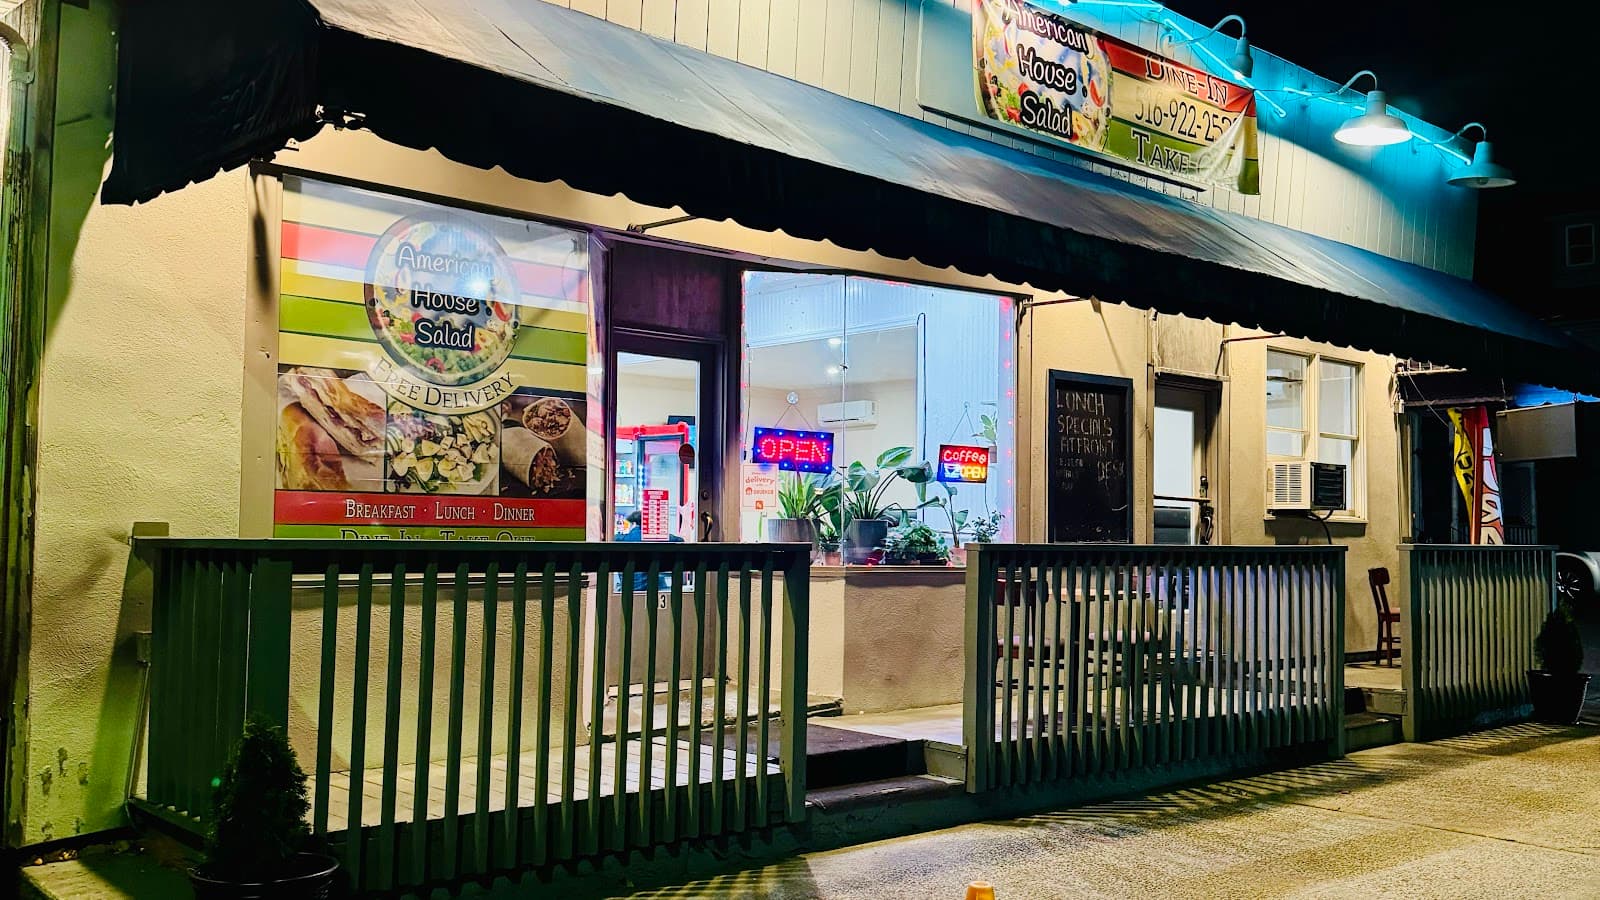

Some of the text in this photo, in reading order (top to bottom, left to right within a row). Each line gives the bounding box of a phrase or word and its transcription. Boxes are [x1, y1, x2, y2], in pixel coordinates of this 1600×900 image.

[1004, 0, 1086, 52] American
[1017, 45, 1076, 92] House
[1146, 54, 1228, 106] DINE-IN
[1021, 94, 1072, 137] Salad
[397, 246, 493, 277] American
[413, 283, 479, 313] House
[415, 322, 473, 348] Salad
[423, 372, 514, 408] DELIVERY
[761, 438, 827, 463] OPEN
[943, 450, 987, 464] Coffee
[345, 499, 535, 521] BREAKFAST LUNCH DINNER
